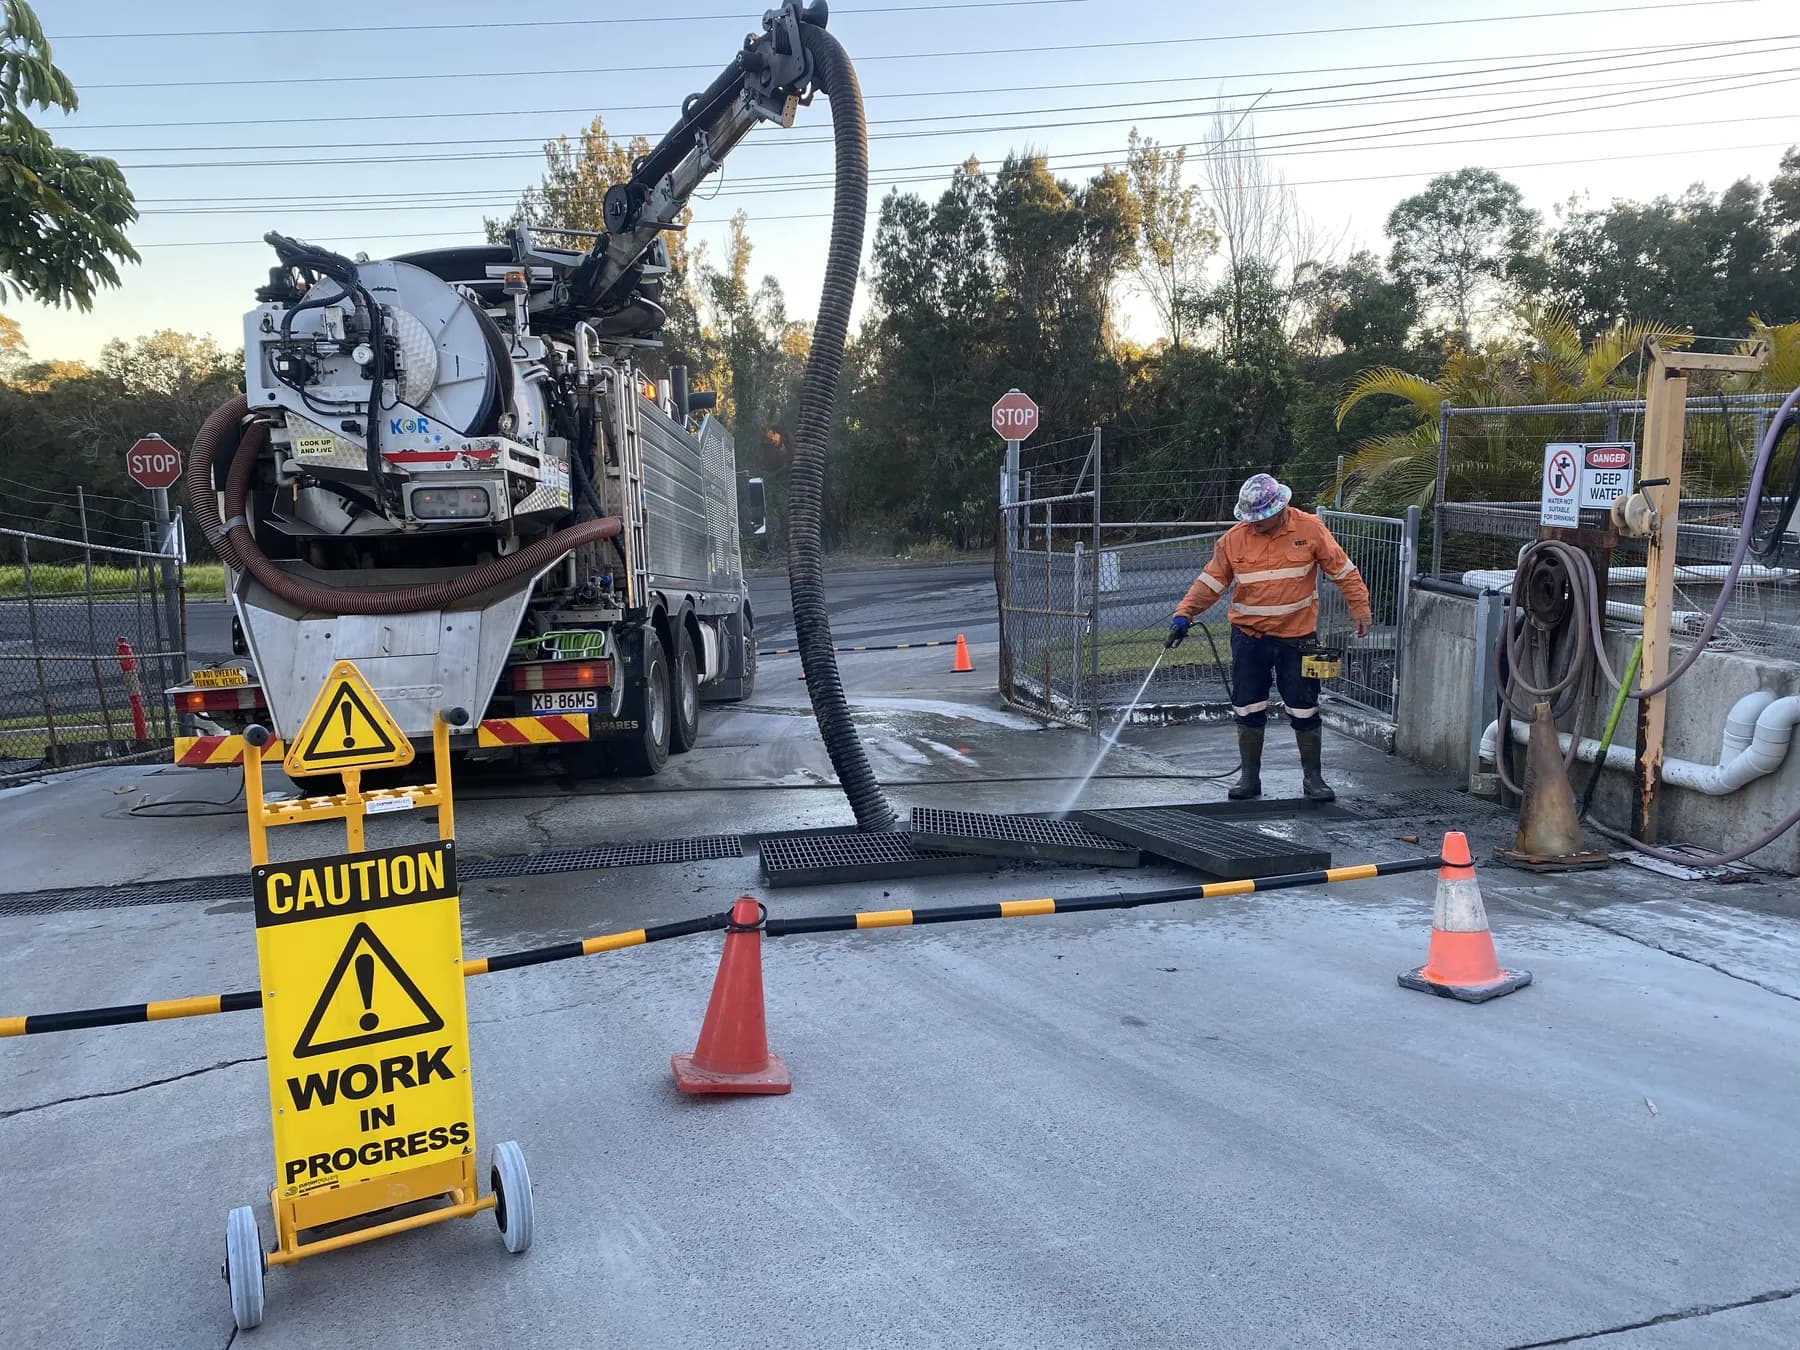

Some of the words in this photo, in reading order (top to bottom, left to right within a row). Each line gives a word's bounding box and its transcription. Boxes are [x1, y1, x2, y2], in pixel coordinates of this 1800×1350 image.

[997, 408, 1034, 426] STOP
[132, 454, 176, 474] STOP
[1593, 453, 1626, 463] DANGER
[1595, 472, 1622, 485] DEEP
[1548, 505, 1570, 514] SUITABLE
[1553, 514, 1576, 522] DRINKING
[594, 720, 639, 730] SPARES
[266, 850, 445, 915] CAUTION
[286, 1045, 456, 1112] WORK
[360, 1104, 395, 1132] IN
[285, 1121, 470, 1185] PROGRESS
